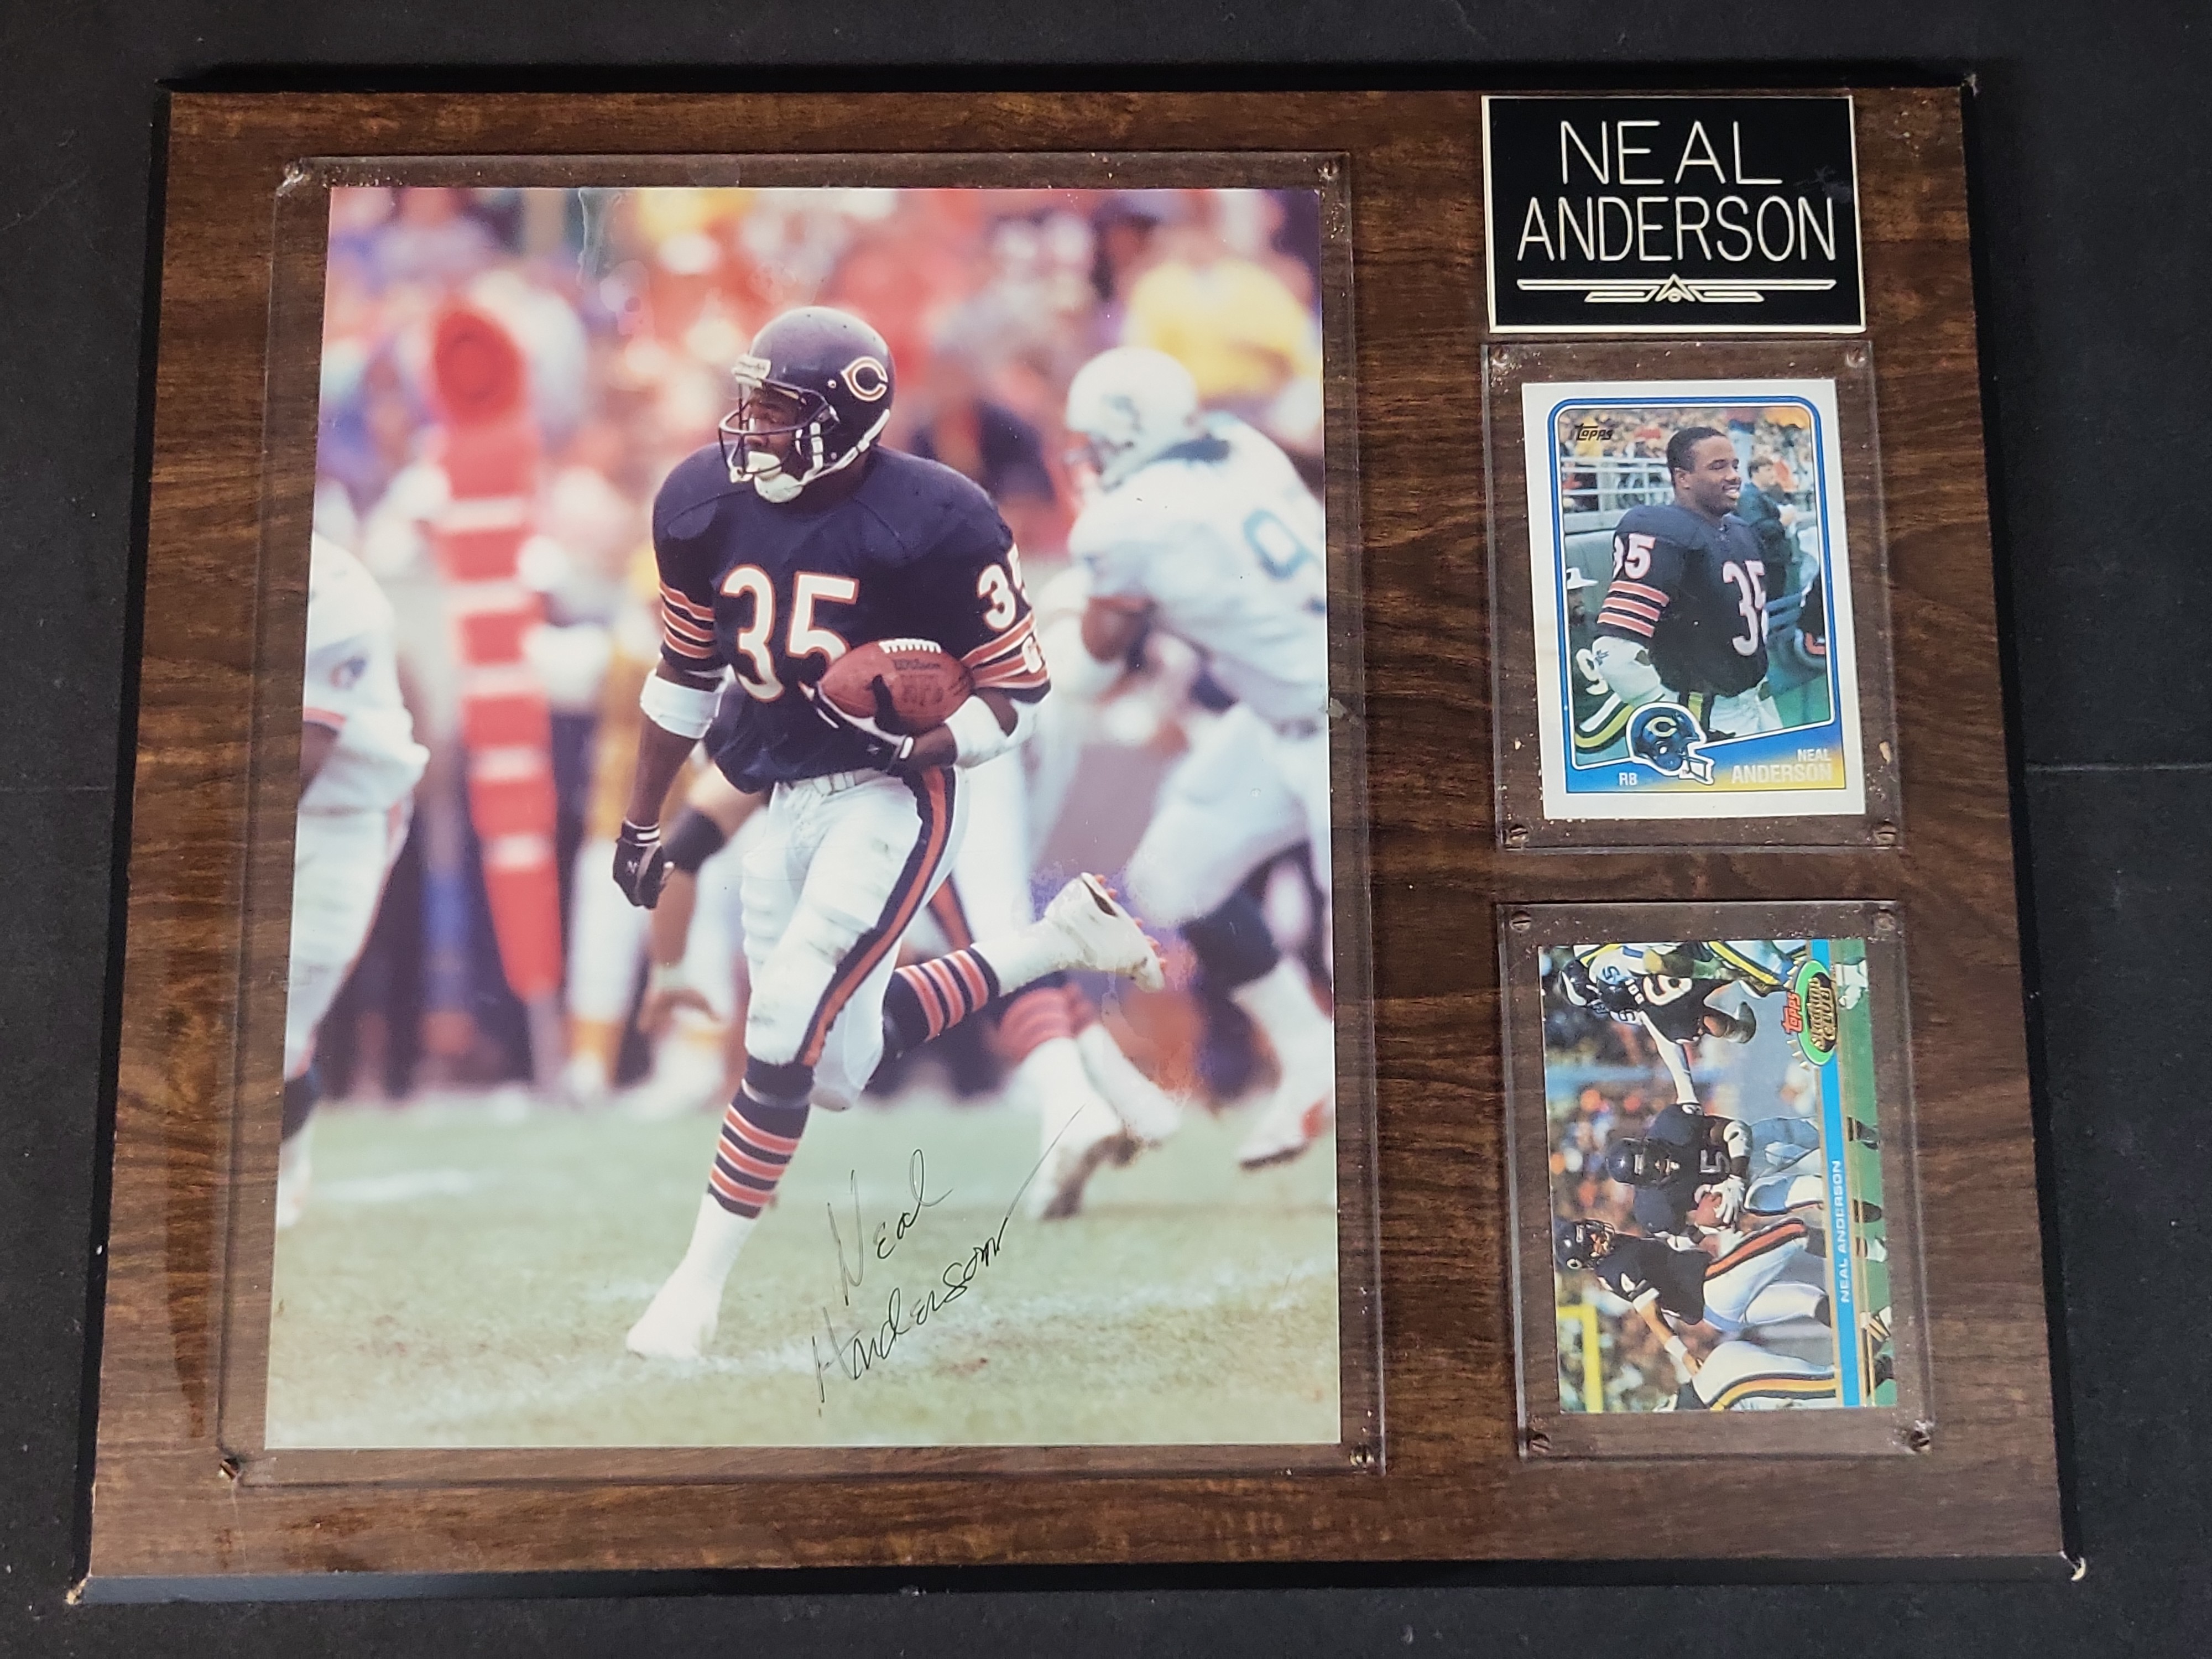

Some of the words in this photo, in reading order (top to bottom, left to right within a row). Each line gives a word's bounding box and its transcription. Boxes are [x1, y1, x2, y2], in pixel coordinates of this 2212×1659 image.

[1560, 120, 1782, 185] NEAL
[1517, 196, 1836, 262] ANDERSON
[720, 563, 860, 703] 35
[1619, 773, 1637, 785] RB
[1731, 762, 1832, 784] ANDERSON
[1797, 748, 1832, 761] NEAL
[827, 1149, 953, 1306] Neal
[1832, 1160, 1846, 1253] ANDERSON
[1838, 1258, 1850, 1302] NEAL
